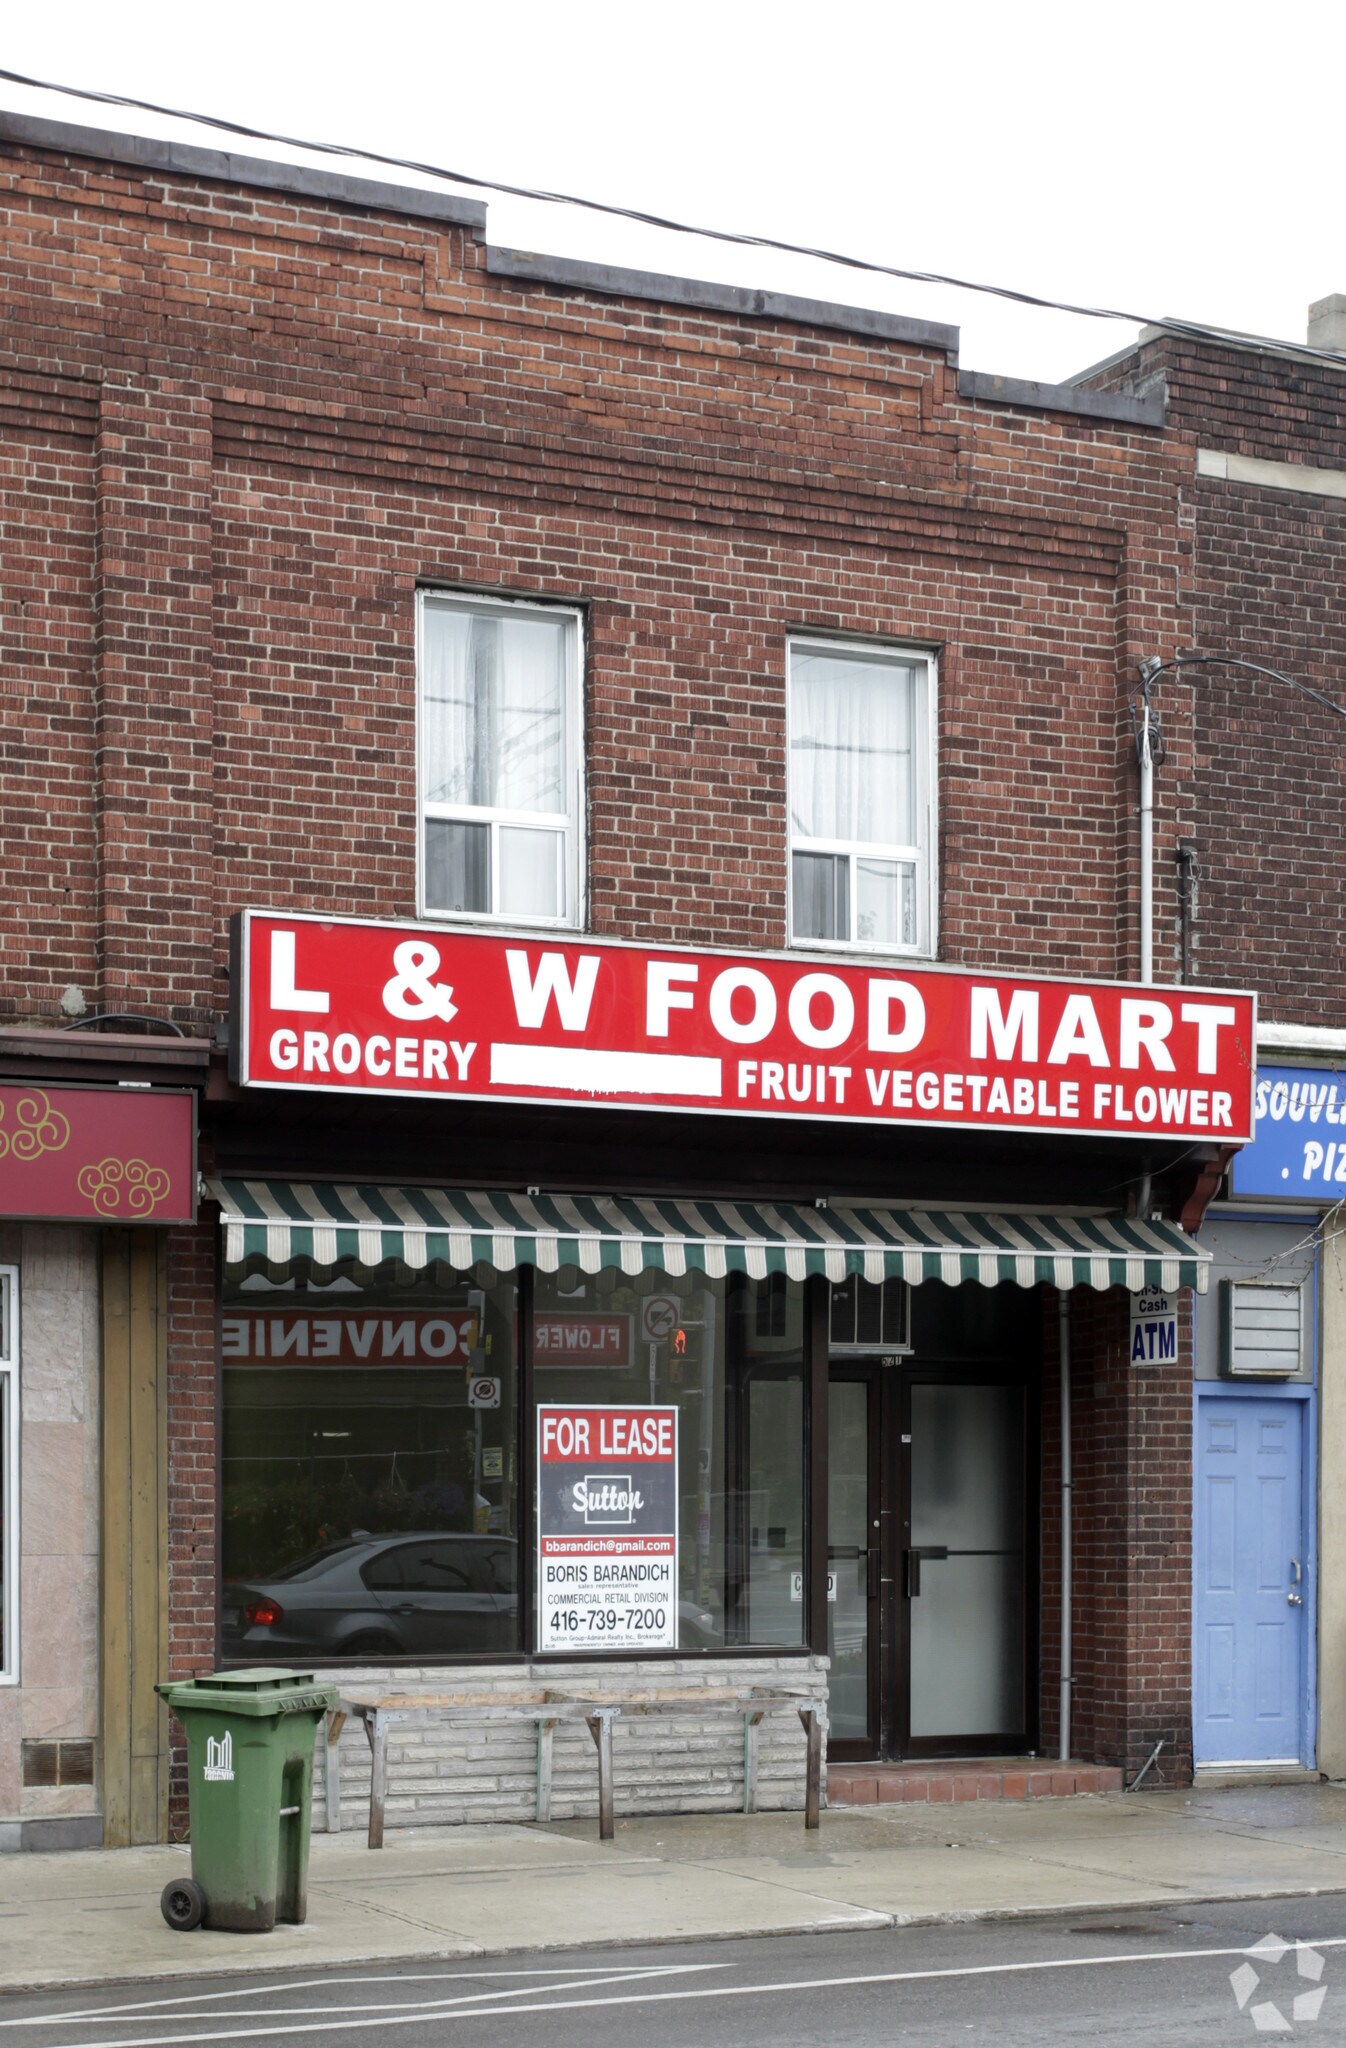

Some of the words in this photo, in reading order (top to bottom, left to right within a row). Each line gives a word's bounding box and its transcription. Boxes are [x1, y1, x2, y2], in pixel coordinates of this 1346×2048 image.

[270, 930, 330, 1014] L
[382, 940, 459, 1023] &
[505, 949, 601, 1032] W
[646, 961, 926, 1053] FOOD
[970, 986, 1236, 1075] MART
[269, 1029, 478, 1081] GROCERY
[738, 1060, 852, 1104] FRUIT
[865, 1068, 1080, 1118] VEGETABLE
[1093, 1083, 1233, 1127] FLOWER
[1255, 1080, 1346, 1126] SOUVL
[1138, 1297, 1168, 1313] Cash
[1131, 1320, 1175, 1361] ATM
[543, 1417, 590, 1456] FOR
[600, 1417, 672, 1456] LEASE
[572, 1481, 644, 1512] Sutton
[545, 1540, 670, 1553] bbarandich@gmail.com
[547, 1565, 588, 1582] BORIS
[594, 1564, 669, 1582] BARANDICH
[548, 1594, 601, 1604] COMMERCIAL
[605, 1593, 631, 1603] RETAIL
[634, 1592, 668, 1603] DIVISION
[550, 1608, 665, 1631] 416-739-7200
